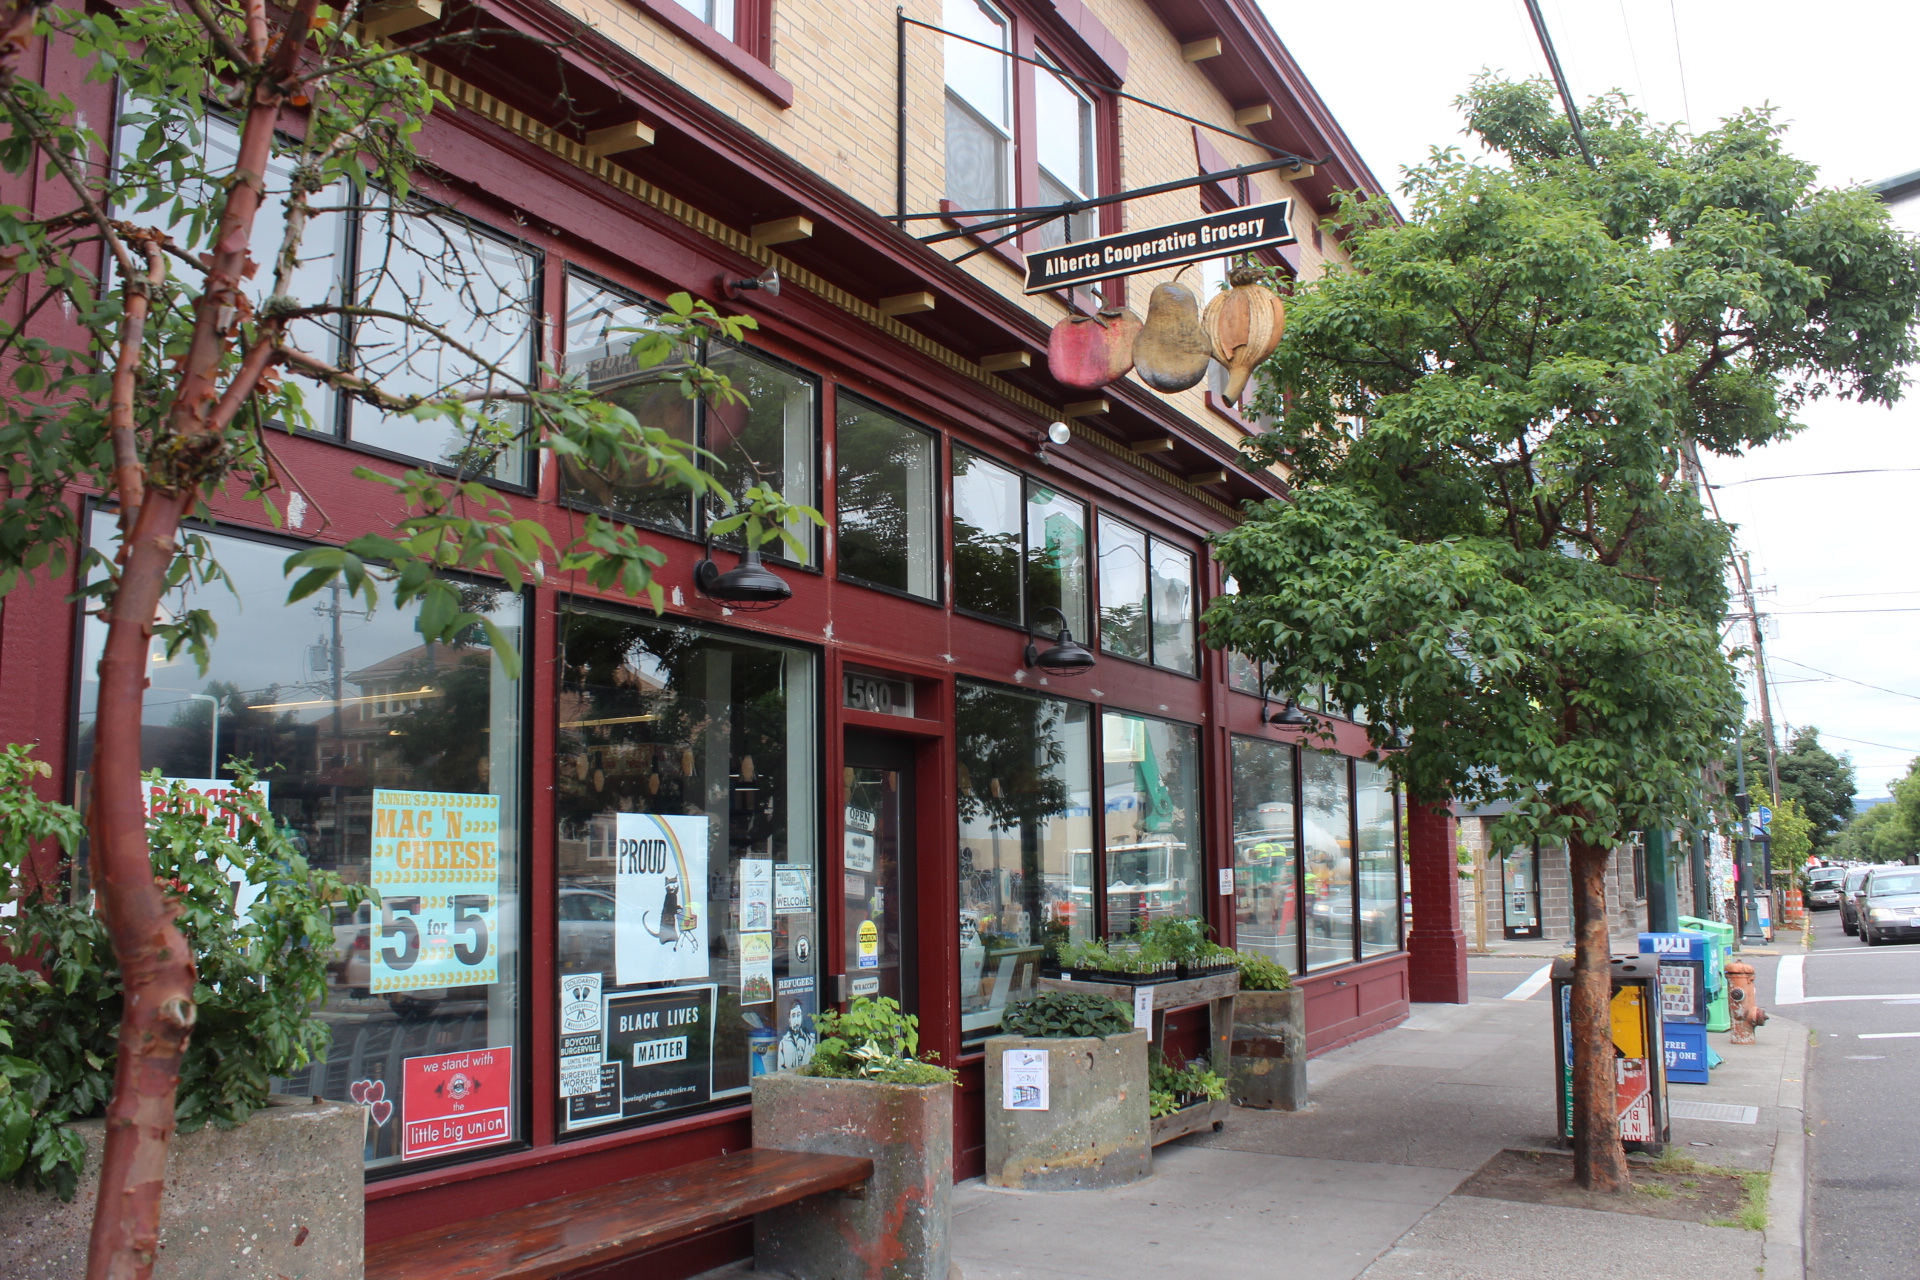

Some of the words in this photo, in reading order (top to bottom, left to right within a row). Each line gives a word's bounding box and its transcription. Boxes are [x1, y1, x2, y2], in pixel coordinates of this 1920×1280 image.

[1045, 252, 1100, 277] Alberta
[1104, 231, 1197, 263] Cooperative
[1200, 217, 1265, 244] Grocery
[843, 676, 891, 712] 1500
[377, 792, 421, 807] ANNIE'S
[849, 808, 871, 824] OPEN
[375, 808, 432, 838] MAC
[441, 807, 463, 839] 'N
[396, 840, 496, 870] CHEESE
[618, 838, 667, 874] PROUD
[776, 896, 810, 907] WELCOME
[381, 896, 421, 971] 5
[427, 919, 448, 936] for
[566, 978, 597, 988] SOLIDARITY
[778, 977, 814, 989] REFUGEES
[862, 982, 877, 990] ACCEPT
[620, 1011, 659, 1033] BLACK
[667, 1007, 699, 1026] LIVES
[564, 1035, 598, 1047] BOYCOTT
[1664, 1041, 1686, 1049] FREE
[560, 1043, 601, 1056] BURGERVILLE
[638, 1041, 683, 1062] MATTER
[1664, 1050, 1677, 1059] KE
[1679, 1051, 1697, 1060] ONE
[423, 1063, 439, 1072] we
[441, 1054, 469, 1071] stand
[472, 1051, 494, 1066] with
[560, 1068, 600, 1080] BURGERVILLE
[563, 1076, 598, 1088] WORKERS
[568, 1085, 593, 1096] UNION
[452, 1101, 465, 1111] the
[411, 1125, 439, 1145] little
[443, 1121, 463, 1141] big
[467, 1118, 503, 1134] union
[1631, 1122, 1641, 1132] IN
